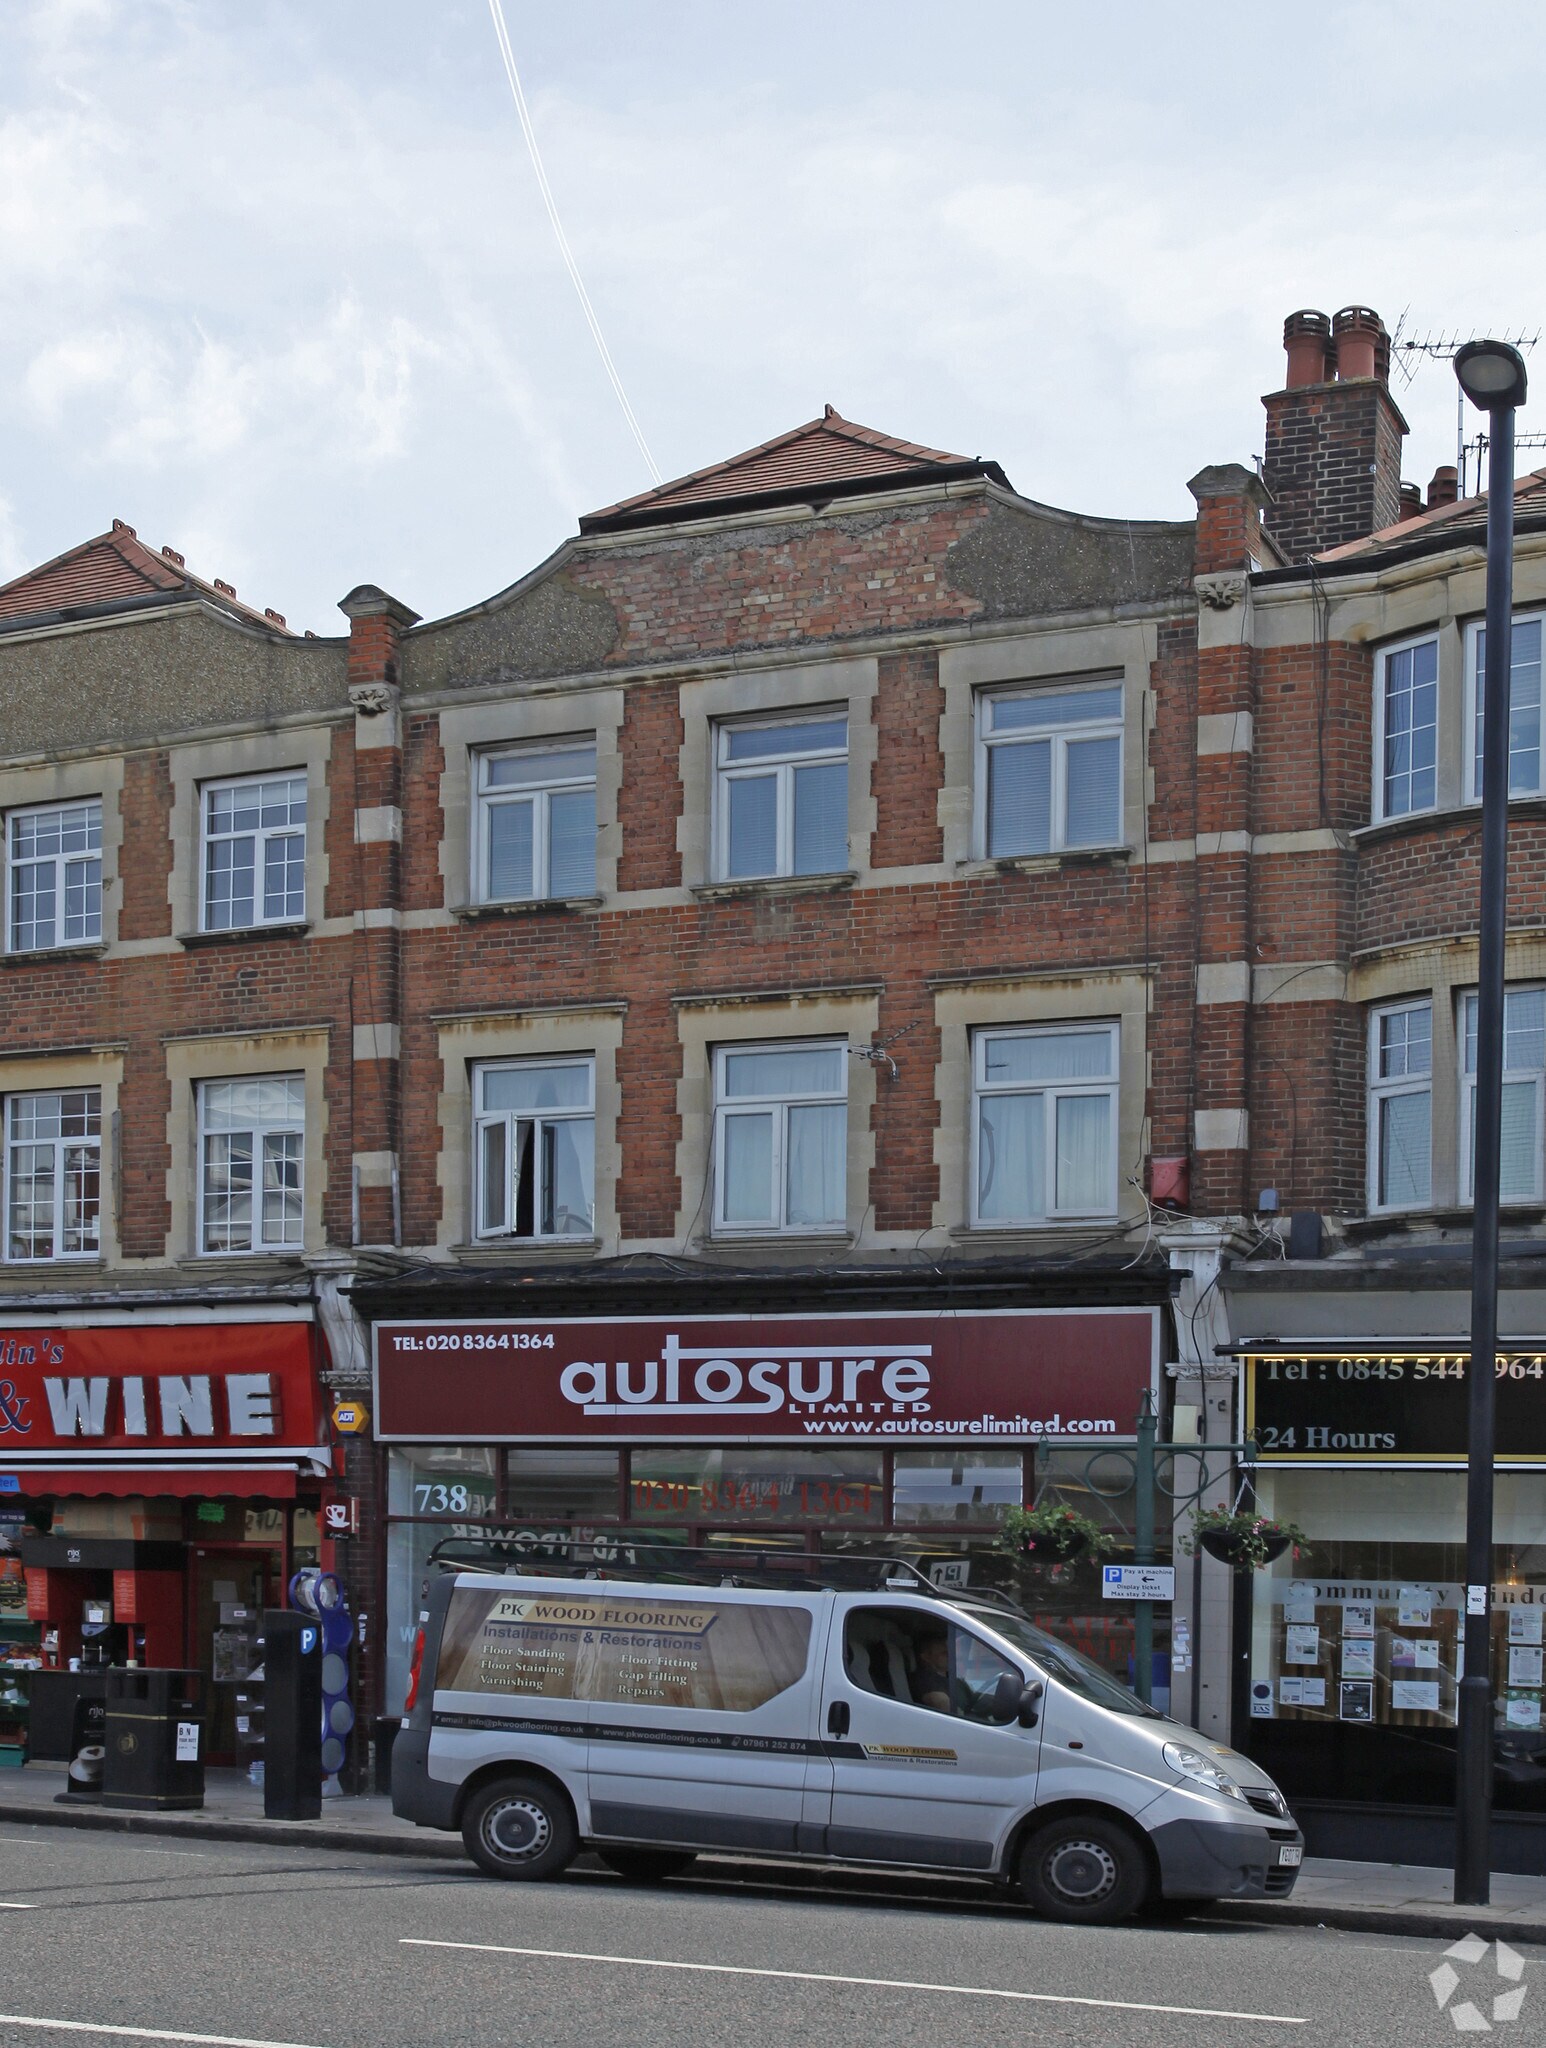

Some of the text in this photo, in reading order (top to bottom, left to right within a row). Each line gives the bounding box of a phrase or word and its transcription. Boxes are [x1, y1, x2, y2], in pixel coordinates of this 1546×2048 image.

[393, 1334, 555, 1351] TEL: 020 8364 1364
[560, 1335, 932, 1416] autosure
[1264, 1359, 1309, 1380] Tel
[1337, 1358, 1405, 1381] 0845
[1413, 1358, 1465, 1380] 544
[0, 1373, 279, 1437] & WINE
[788, 1402, 931, 1415] LIMITED
[338, 1412, 355, 1422] ADT
[803, 1414, 1116, 1435] www.autosurelimited.com
[1263, 1426, 1396, 1450] 24 Hours
[414, 1484, 468, 1513] 738
[635, 1480, 689, 1511] 020
[701, 1481, 780, 1514] 8364
[800, 1482, 873, 1515] 1364
[1109, 1569, 1120, 1582] P
[500, 1603, 704, 1629] PK WOOD FLOORING
[303, 1629, 313, 1650] P
[483, 1625, 702, 1651] Installations & Restorations
[482, 1645, 566, 1662] Floor Sanding
[480, 1660, 565, 1677] Floor Staining
[621, 1654, 698, 1671] Floor Fitting
[480, 1674, 543, 1691] Varnishing
[618, 1669, 688, 1686] Gap Filling
[617, 1684, 665, 1699] Repairs
[602, 1727, 723, 1746] www.pkwoodflooring.co.uk
[743, 1738, 769, 1748] 07961
[790, 1741, 806, 1751] 874
[868, 1755, 907, 1763] Installations
[916, 1758, 957, 1766] Restorations
[912, 1748, 955, 1757] FLOORING
